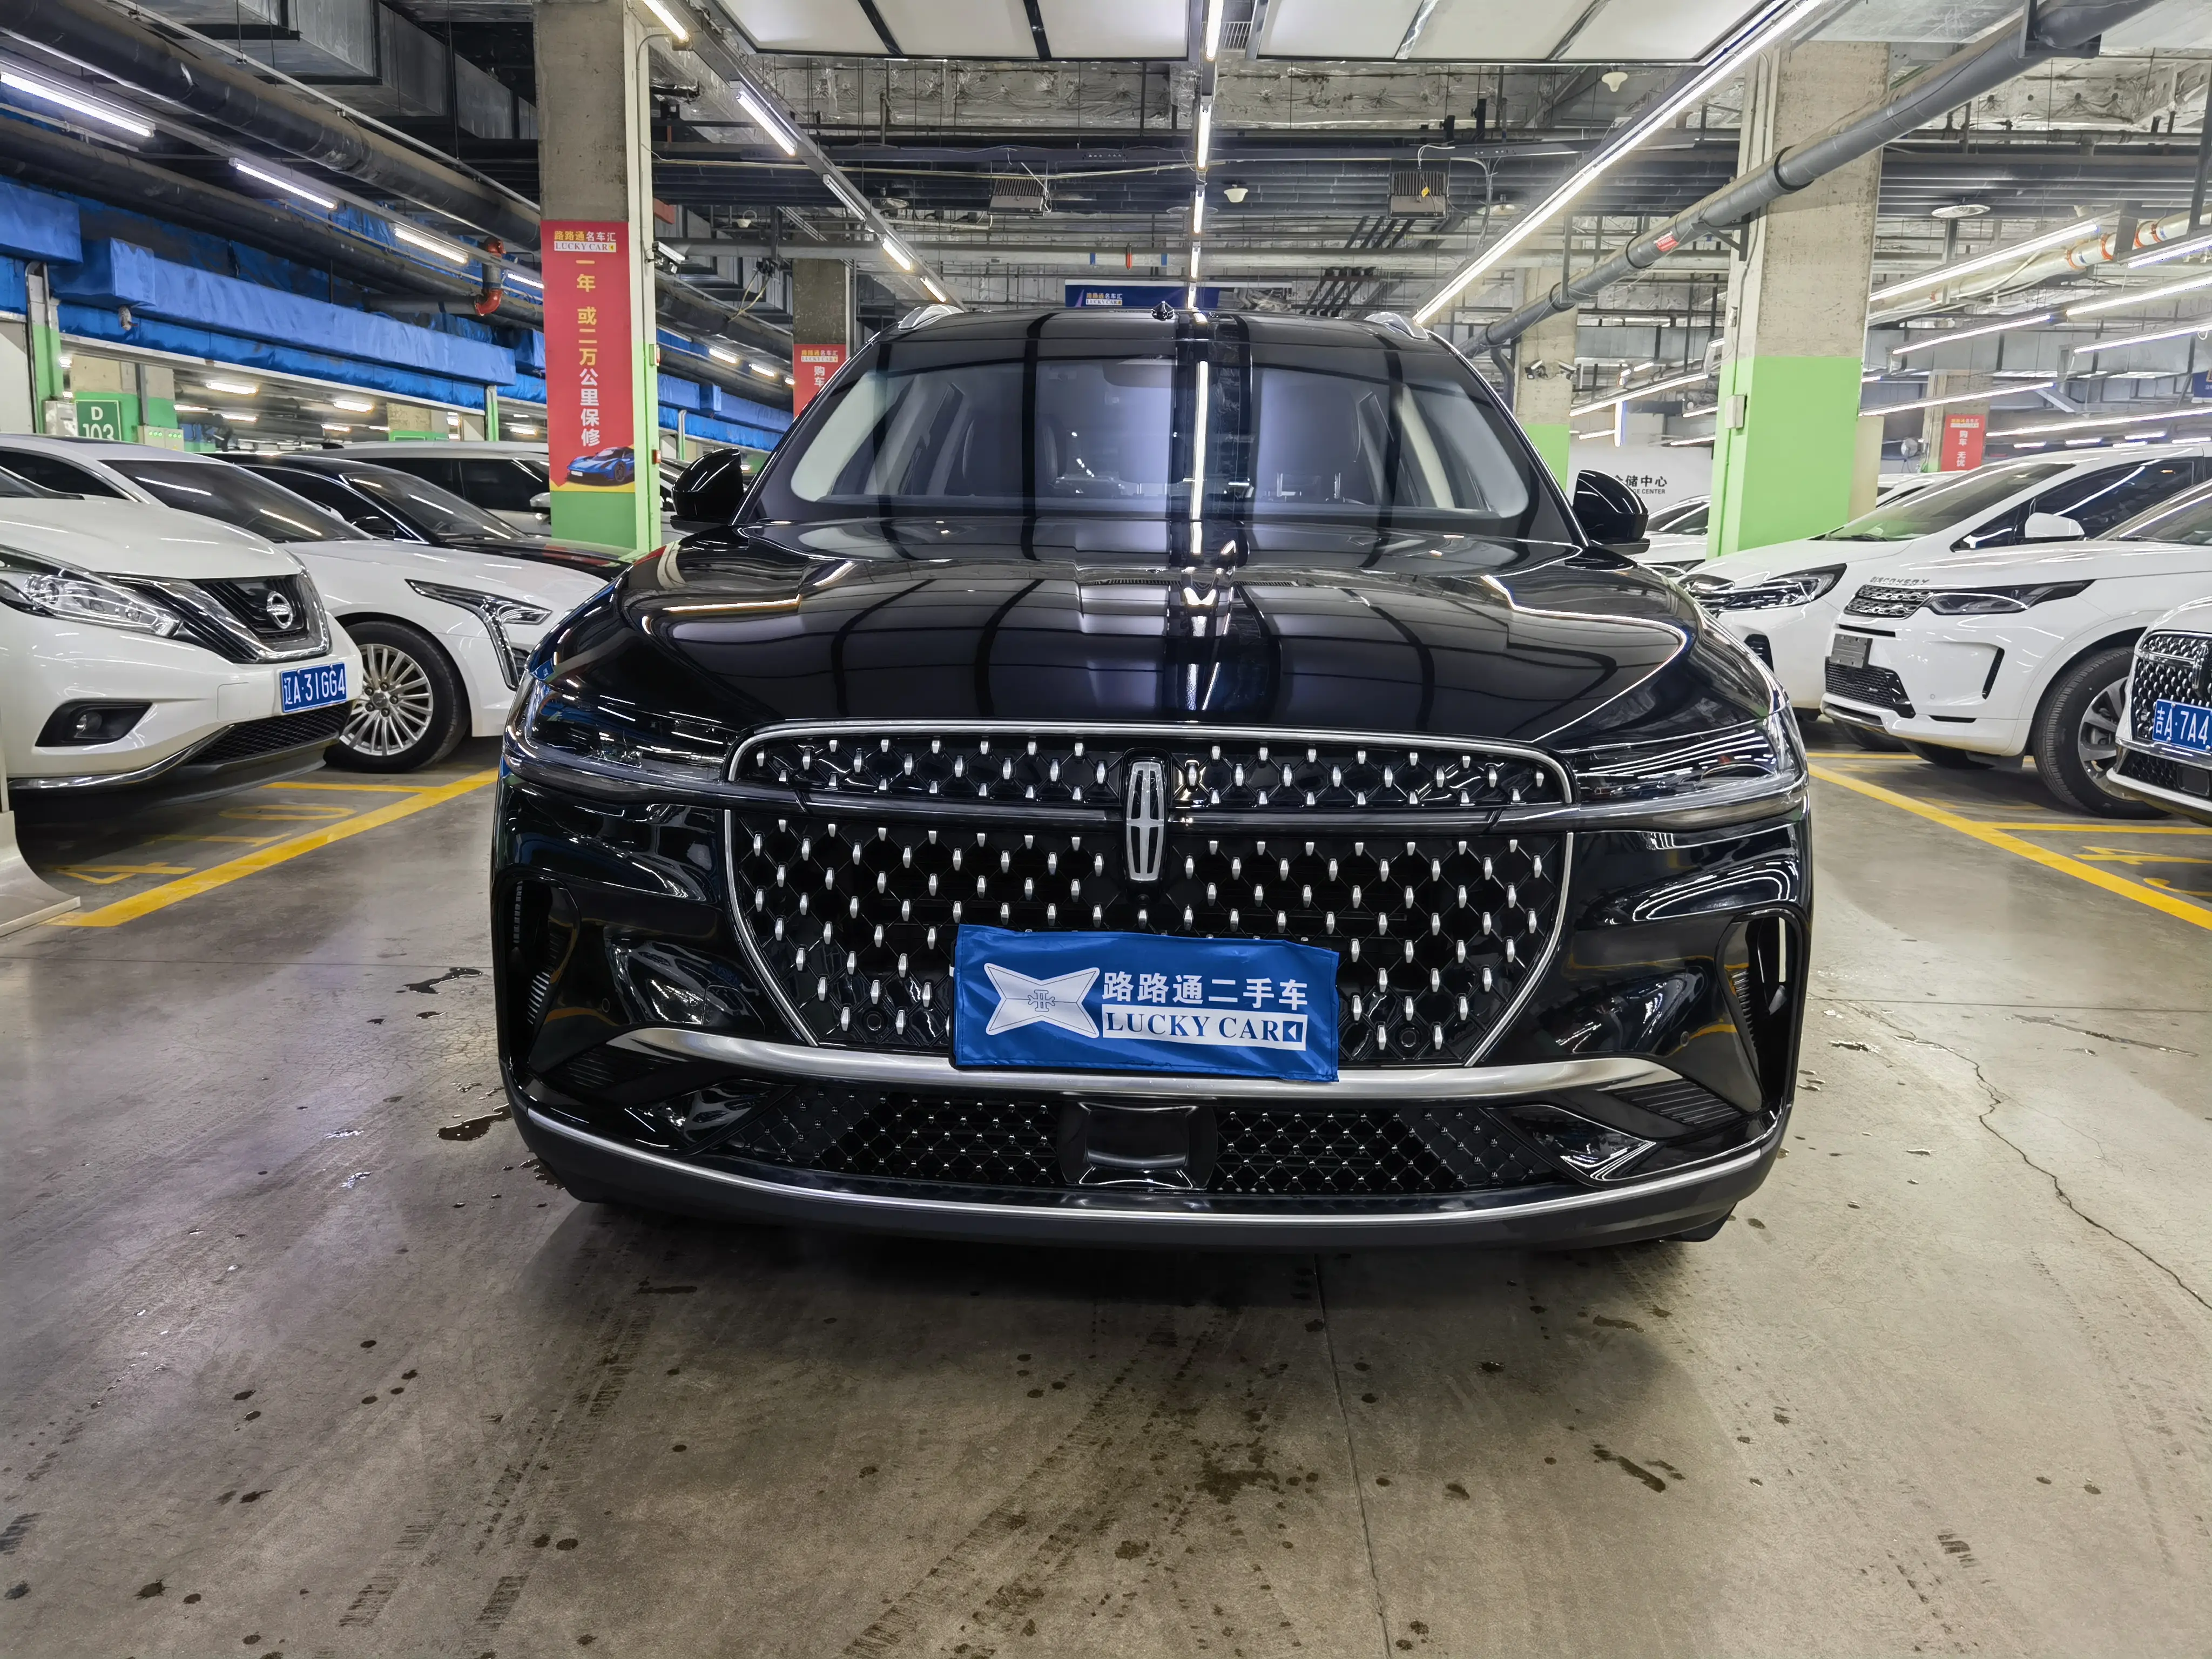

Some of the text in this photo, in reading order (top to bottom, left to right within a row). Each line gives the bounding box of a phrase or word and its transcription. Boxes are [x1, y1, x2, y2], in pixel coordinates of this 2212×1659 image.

[554, 231, 616, 242] 路路通名车汇
[555, 242, 586, 251] LUCKY
[576, 260, 600, 447] 一年 或二万公里保修
[91, 406, 104, 421] D
[2155, 706, 2212, 745] 吉A·7A4
[1102, 971, 1308, 1011] 路路通二手车
[1105, 1012, 1280, 1042] LUCKY CAR
